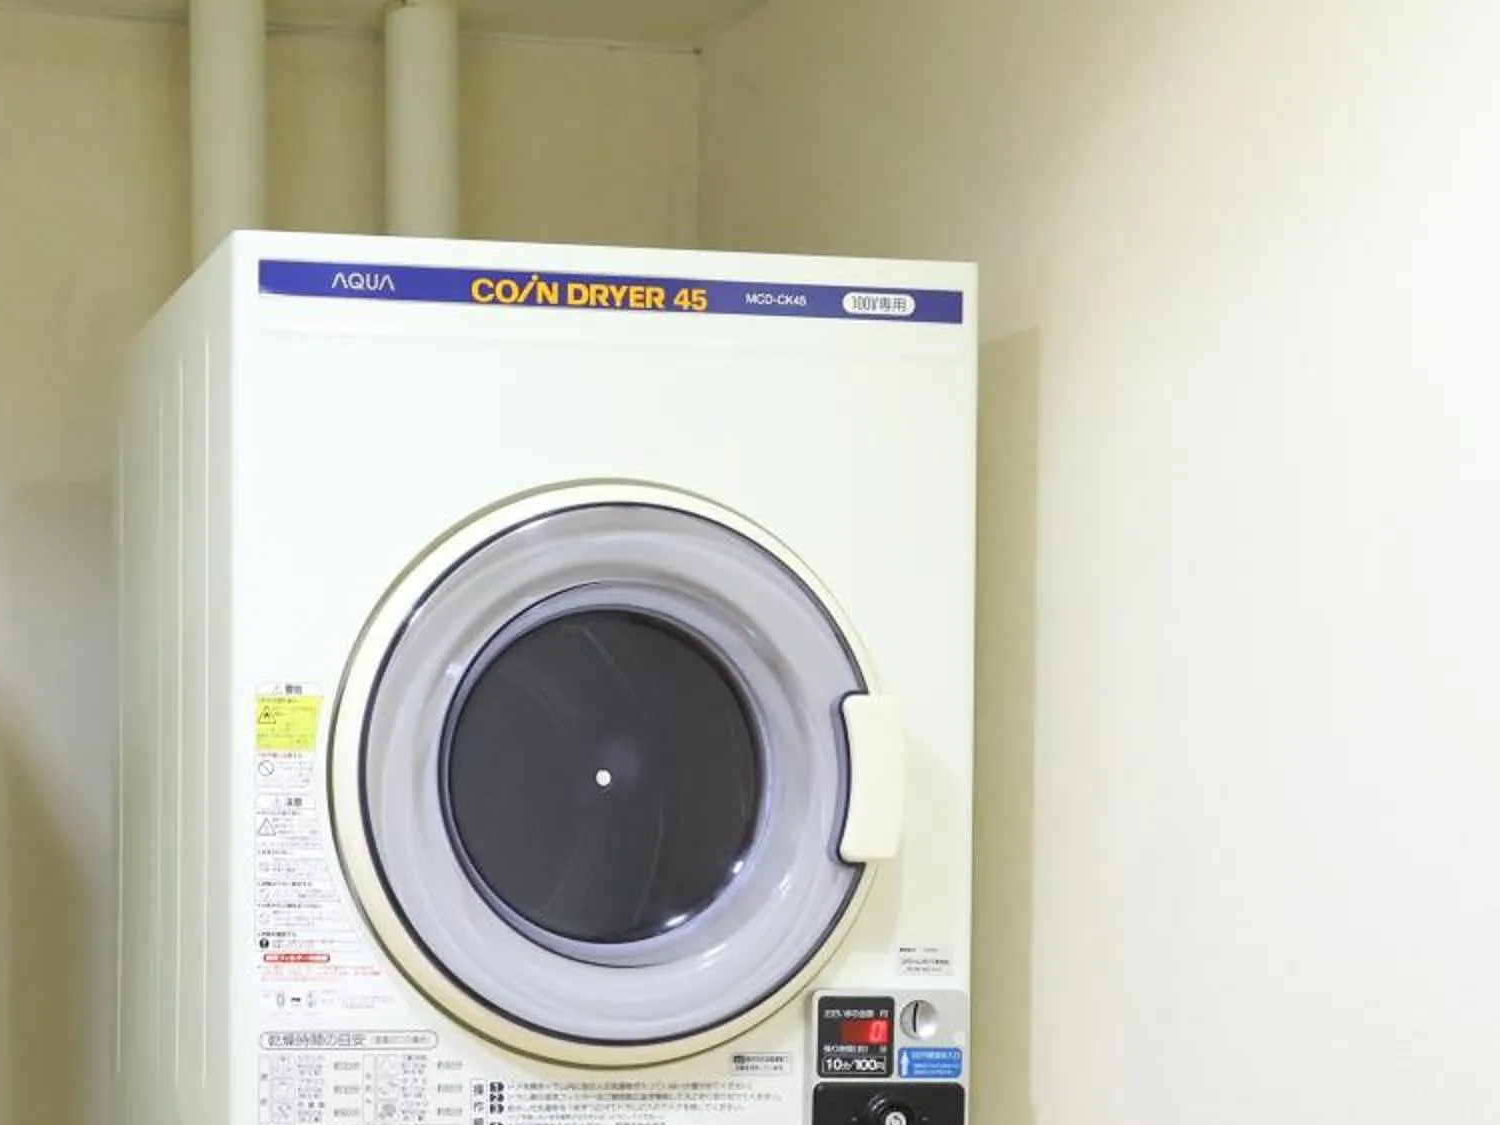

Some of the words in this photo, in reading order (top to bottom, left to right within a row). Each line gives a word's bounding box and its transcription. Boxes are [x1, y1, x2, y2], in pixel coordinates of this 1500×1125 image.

[331, 272, 396, 292] AQUA
[566, 282, 666, 311] DRYER
[674, 287, 709, 313] 45
